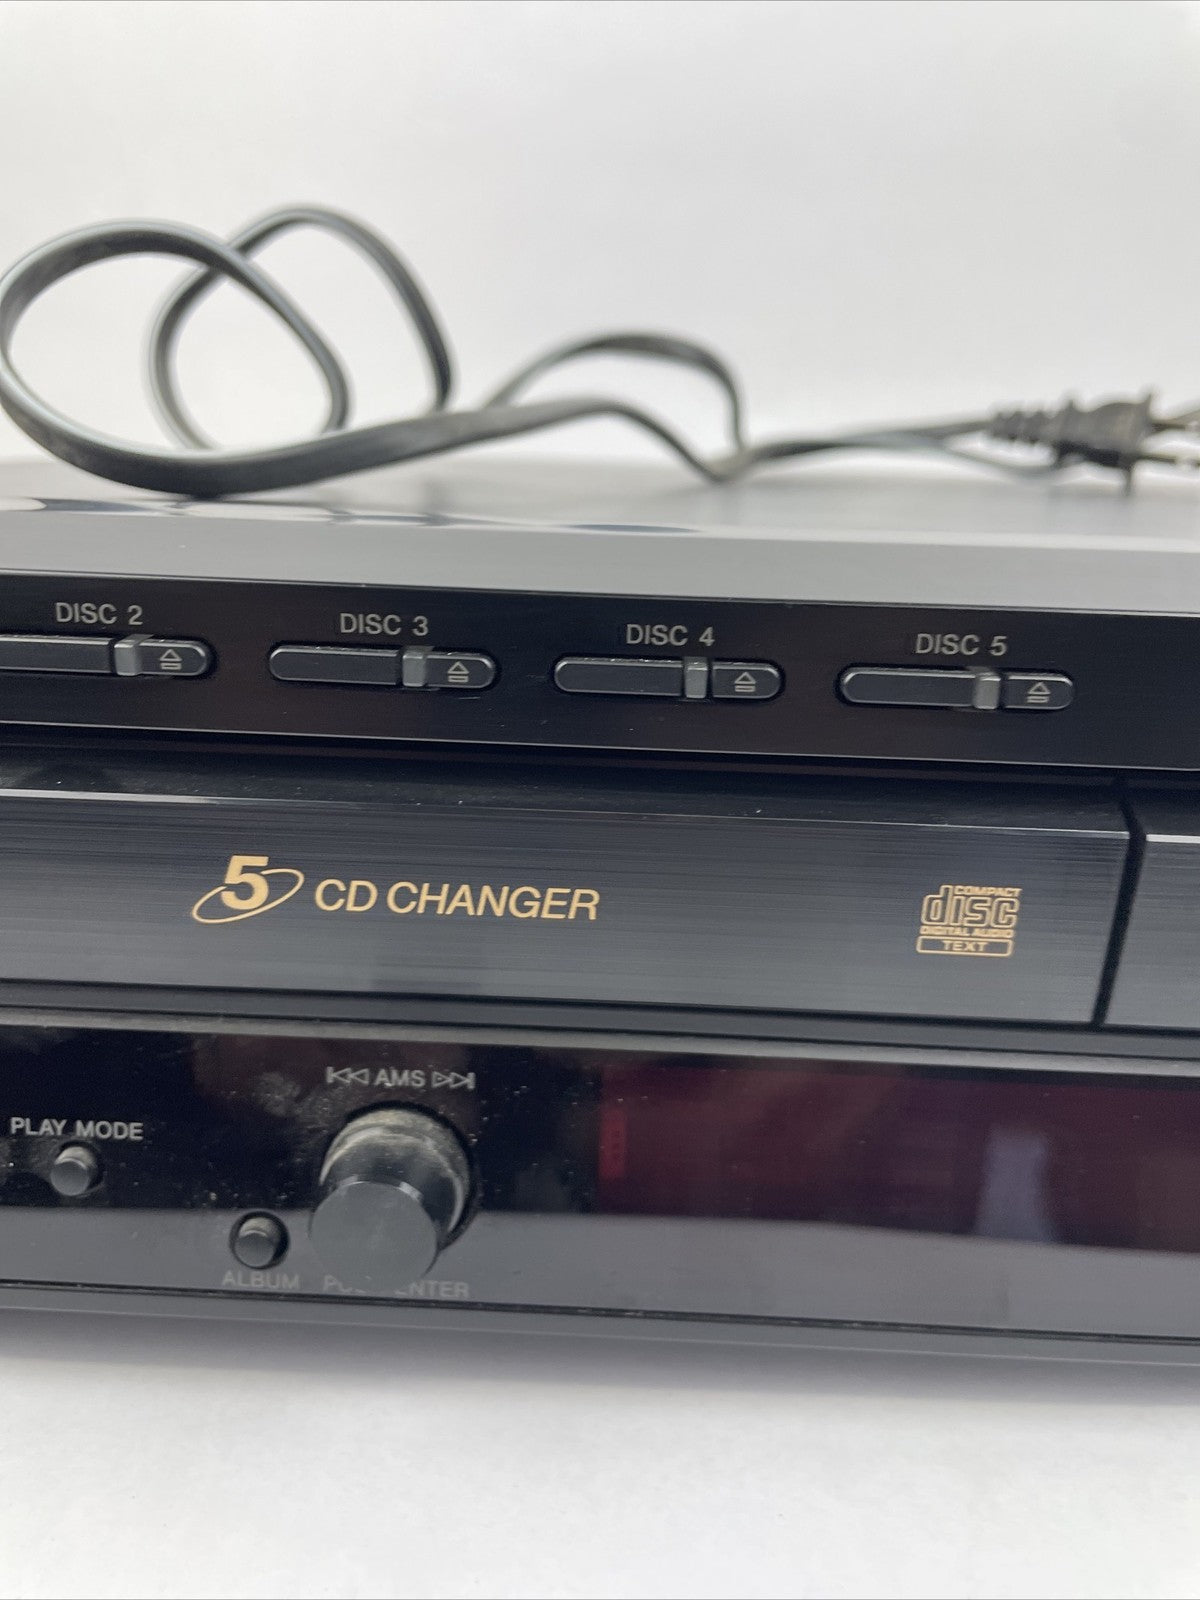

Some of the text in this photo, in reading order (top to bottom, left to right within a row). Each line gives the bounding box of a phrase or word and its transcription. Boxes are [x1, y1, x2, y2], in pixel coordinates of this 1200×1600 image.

[54, 601, 143, 625] DISC 2
[339, 613, 429, 636] DISC 3
[626, 623, 715, 647] DISC 4
[915, 633, 1007, 656] DISC 5
[220, 854, 601, 920] 5 CD CHANGER
[954, 885, 1022, 897] COMPACT
[942, 940, 988, 951] TEXT
[374, 1070, 426, 1088] AMS
[10, 1117, 143, 1140] PLAY MODE
[222, 1269, 300, 1290] ALBUM
[394, 1279, 470, 1298] NTER
